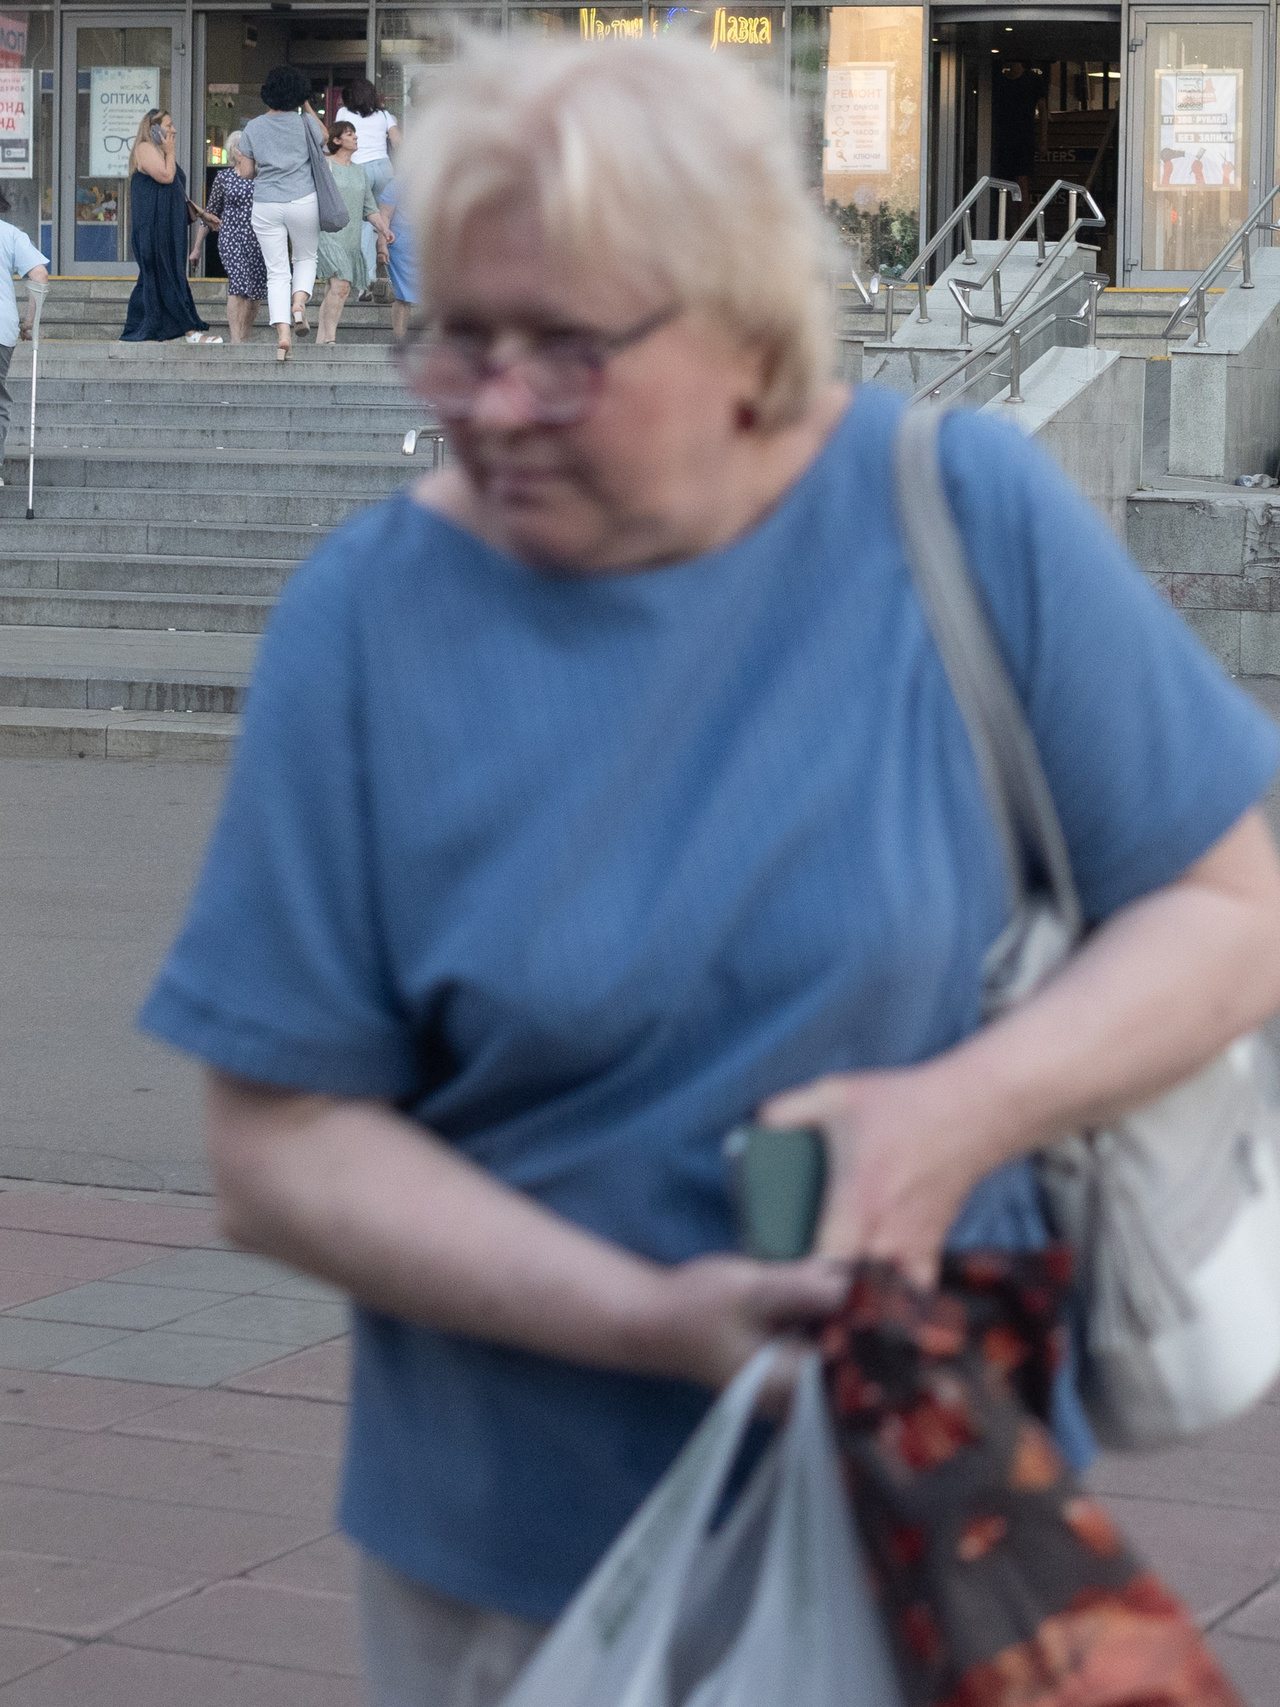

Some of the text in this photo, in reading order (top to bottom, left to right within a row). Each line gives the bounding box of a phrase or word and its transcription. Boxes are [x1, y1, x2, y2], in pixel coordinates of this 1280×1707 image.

[710, 7, 772, 52] Лавка
[833, 88, 882, 99] РЕМОНТ
[100, 93, 150, 105] ОПТИКА
[1163, 116, 1173, 124] ОТ
[1196, 114, 1227, 124] РУБЛЕЙ
[1178, 133, 1234, 142] БЕЗ ЗАПИСИ
[853, 152, 880, 160] КЛЮЧИ
